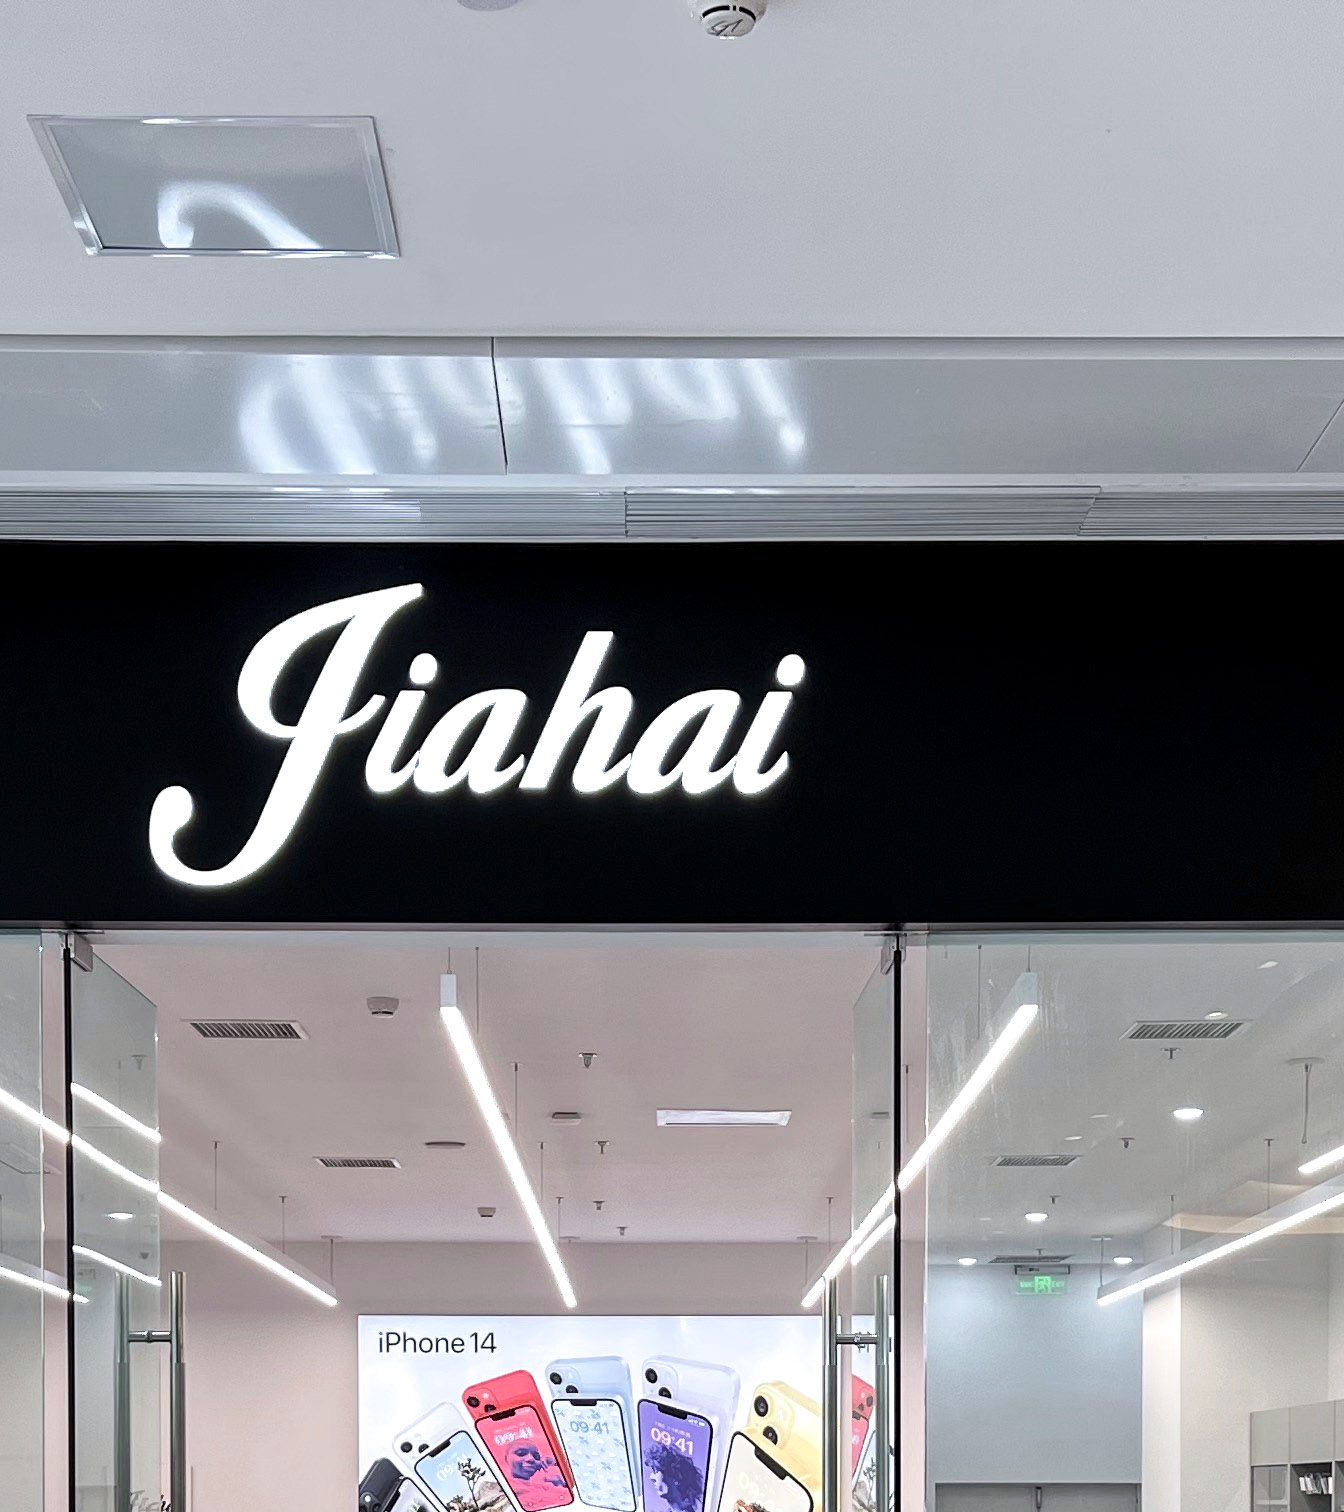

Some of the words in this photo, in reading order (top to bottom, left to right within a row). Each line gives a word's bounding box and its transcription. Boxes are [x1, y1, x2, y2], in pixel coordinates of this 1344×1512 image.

[149, 582, 806, 887] Jiahai
[378, 1331, 465, 1354] iPhone
[469, 1331, 498, 1354] 14
[650, 1427, 694, 1456] 09:41
